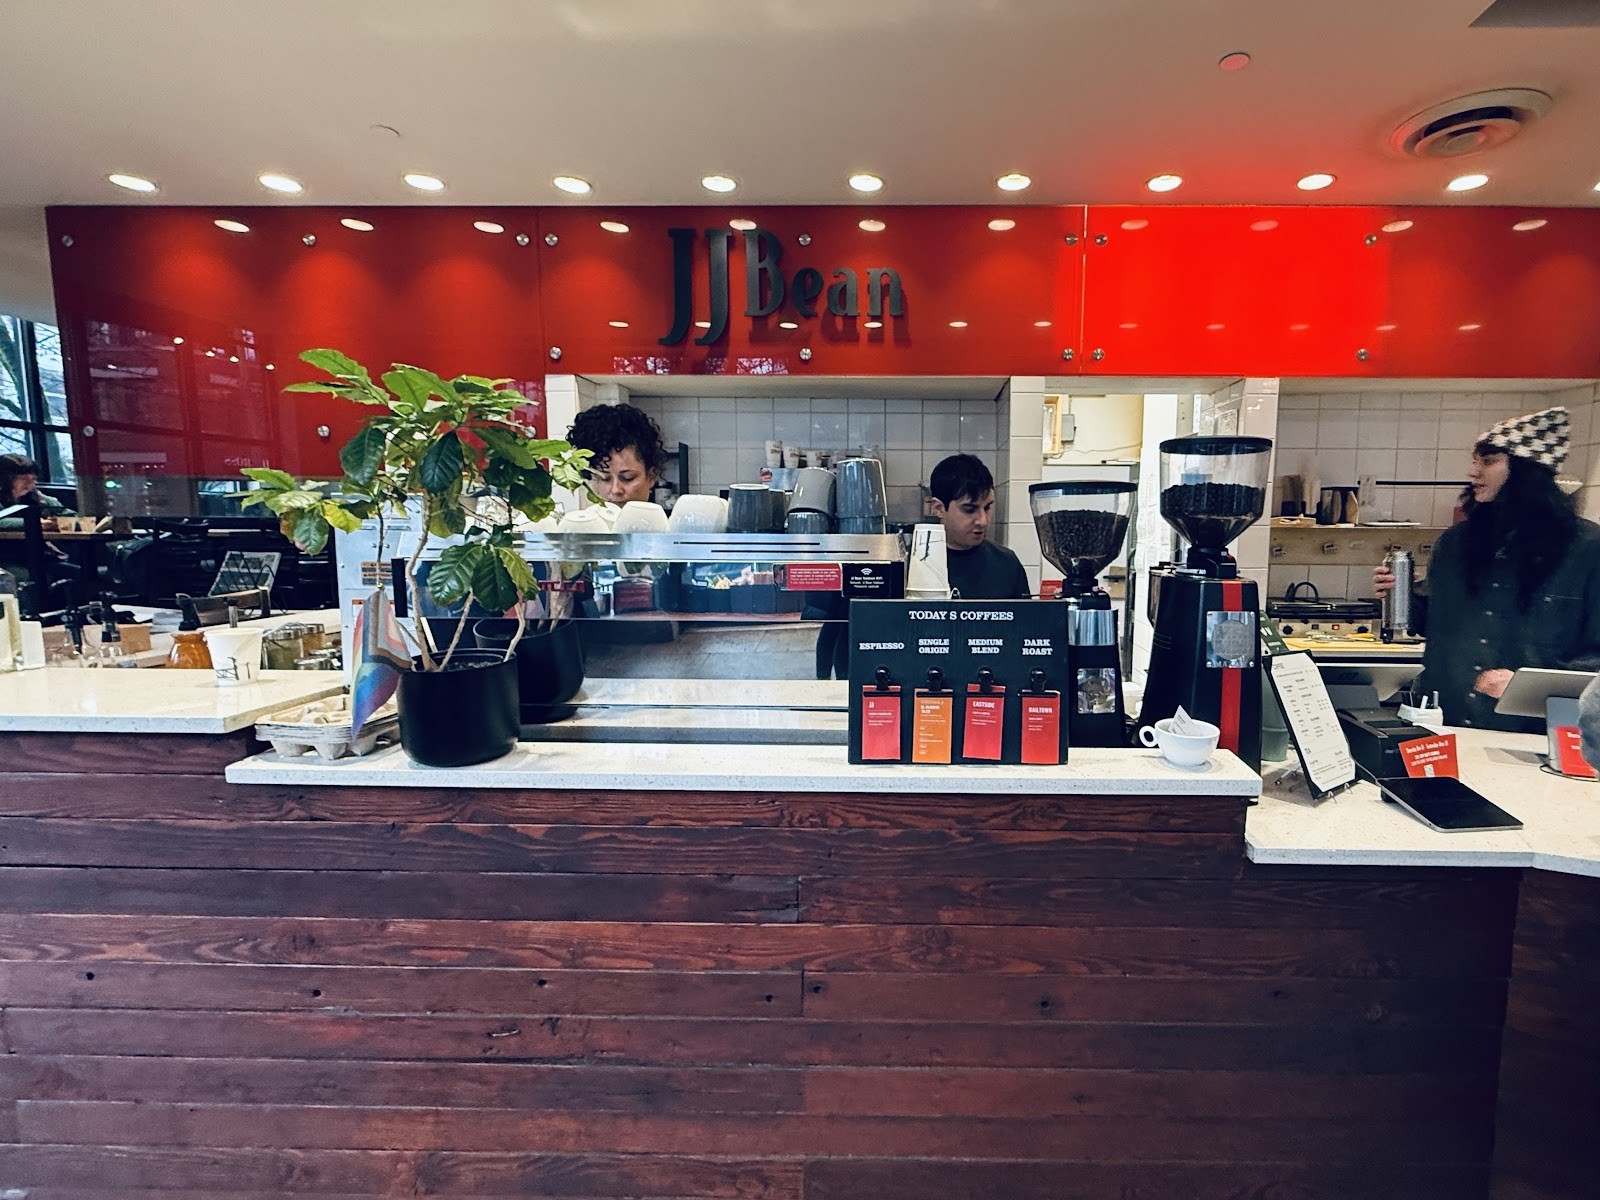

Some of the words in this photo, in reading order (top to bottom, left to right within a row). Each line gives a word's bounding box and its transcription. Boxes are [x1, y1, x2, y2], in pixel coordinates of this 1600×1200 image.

[658, 228, 732, 346] JJ
[742, 228, 904, 317] Bean
[960, 611, 1014, 621] COFFEES
[859, 642, 905, 650] ESPRESSO
[918, 638, 950, 646] SINGLE
[967, 638, 1003, 646] MEDIUM
[1023, 639, 1051, 647] DARK
[1022, 648, 1053, 656] ROAST
[972, 701, 995, 709] EASTSIDE
[1028, 706, 1053, 714] RAILTOWN
